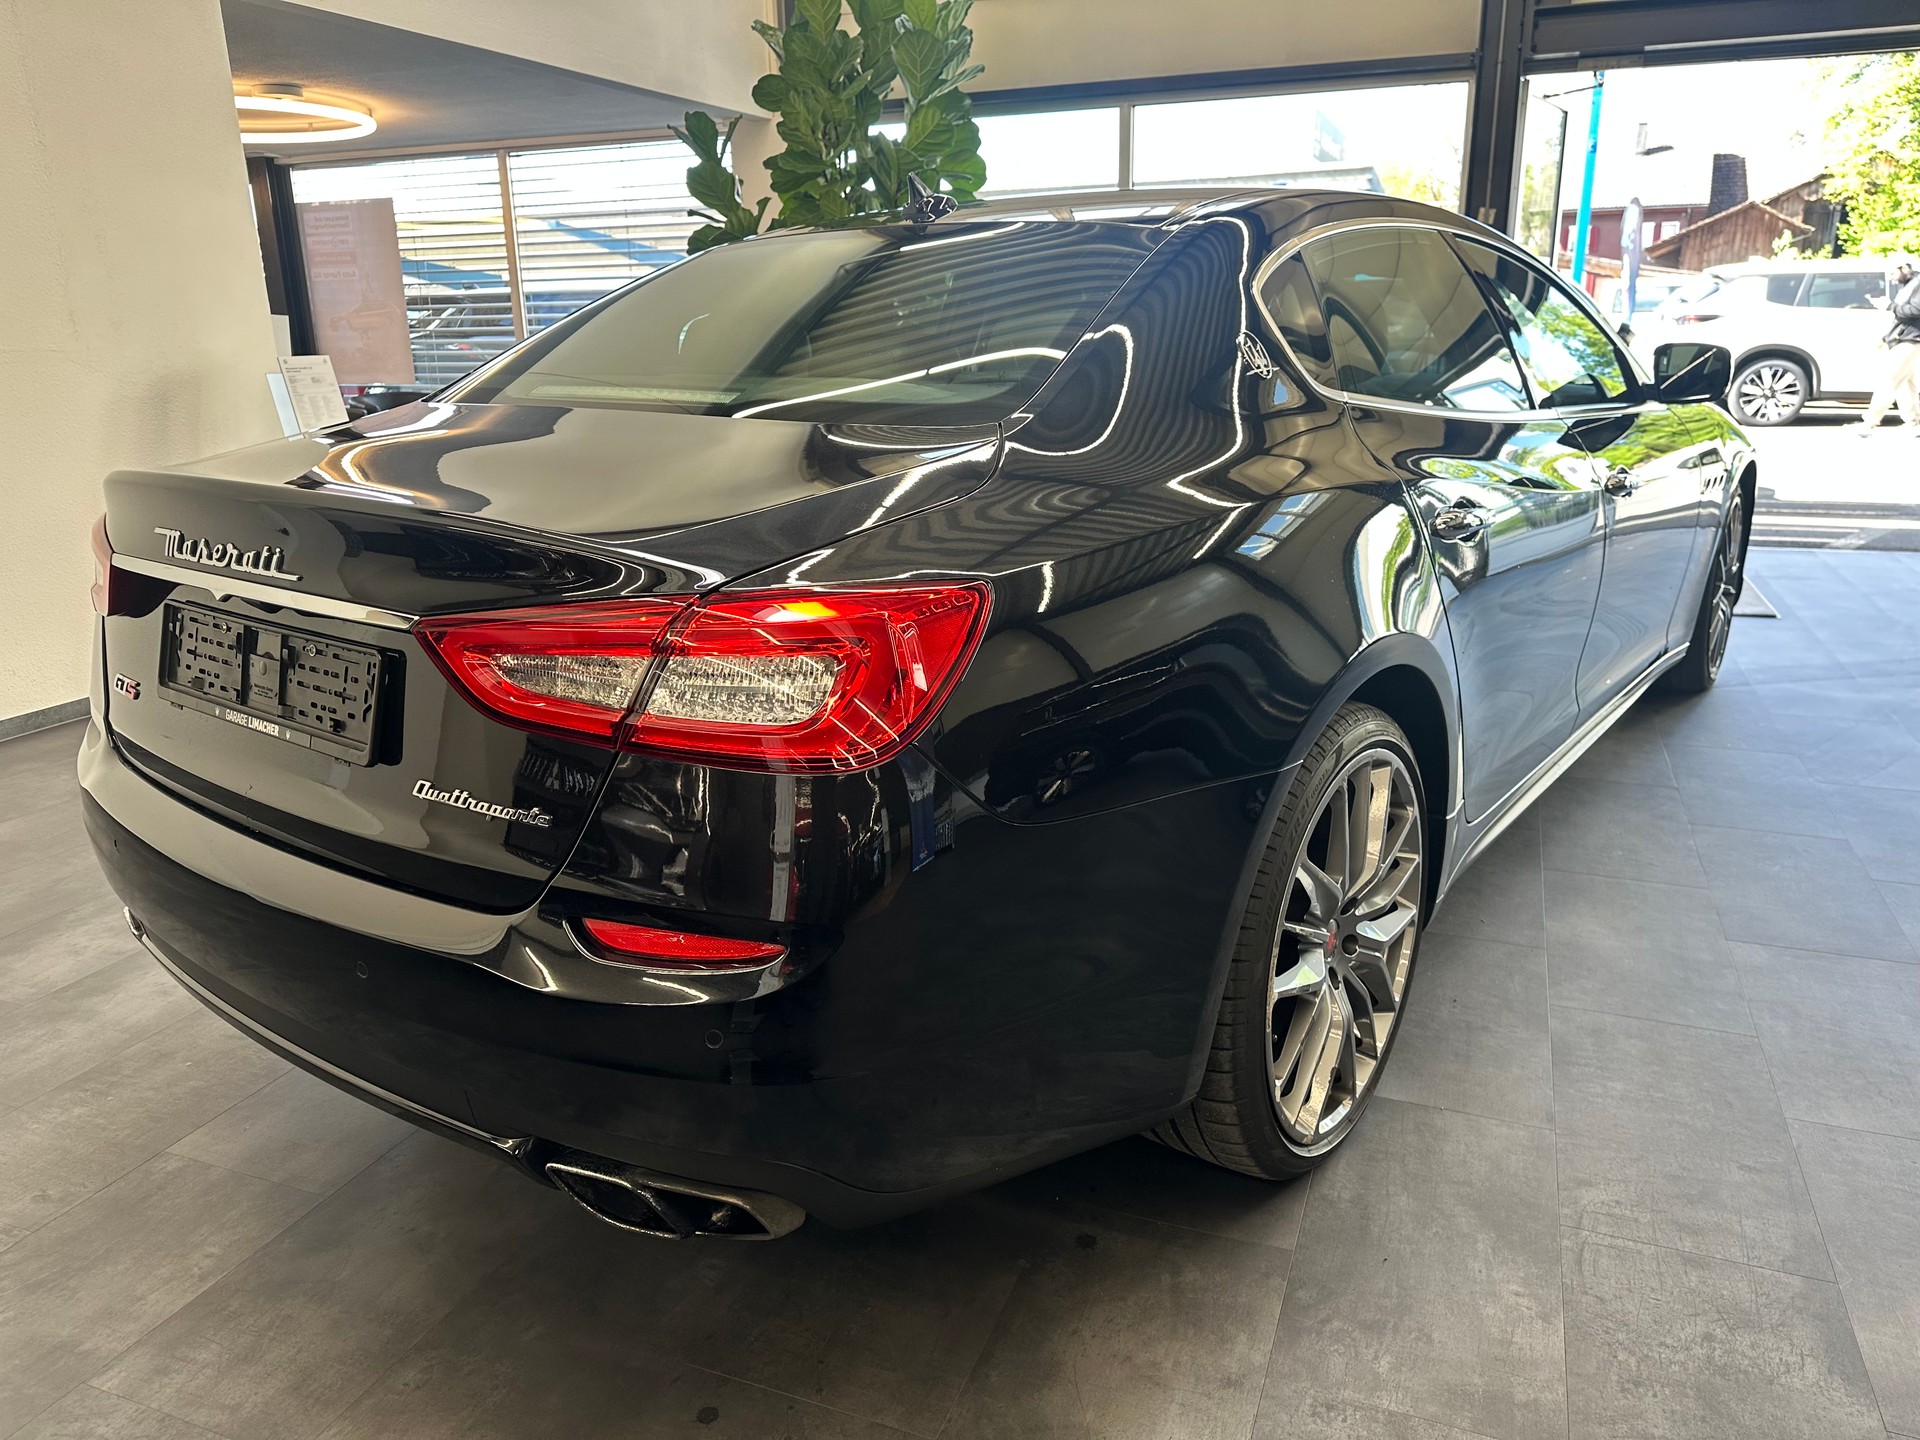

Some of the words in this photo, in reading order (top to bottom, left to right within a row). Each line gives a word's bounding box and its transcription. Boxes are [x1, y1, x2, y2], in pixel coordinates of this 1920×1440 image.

[154, 526, 304, 582] Maserati
[113, 673, 141, 701] GTS
[226, 709, 248, 727] GARAGE
[248, 716, 280, 737] LIMACHER
[412, 779, 553, 827] Quattroporte
